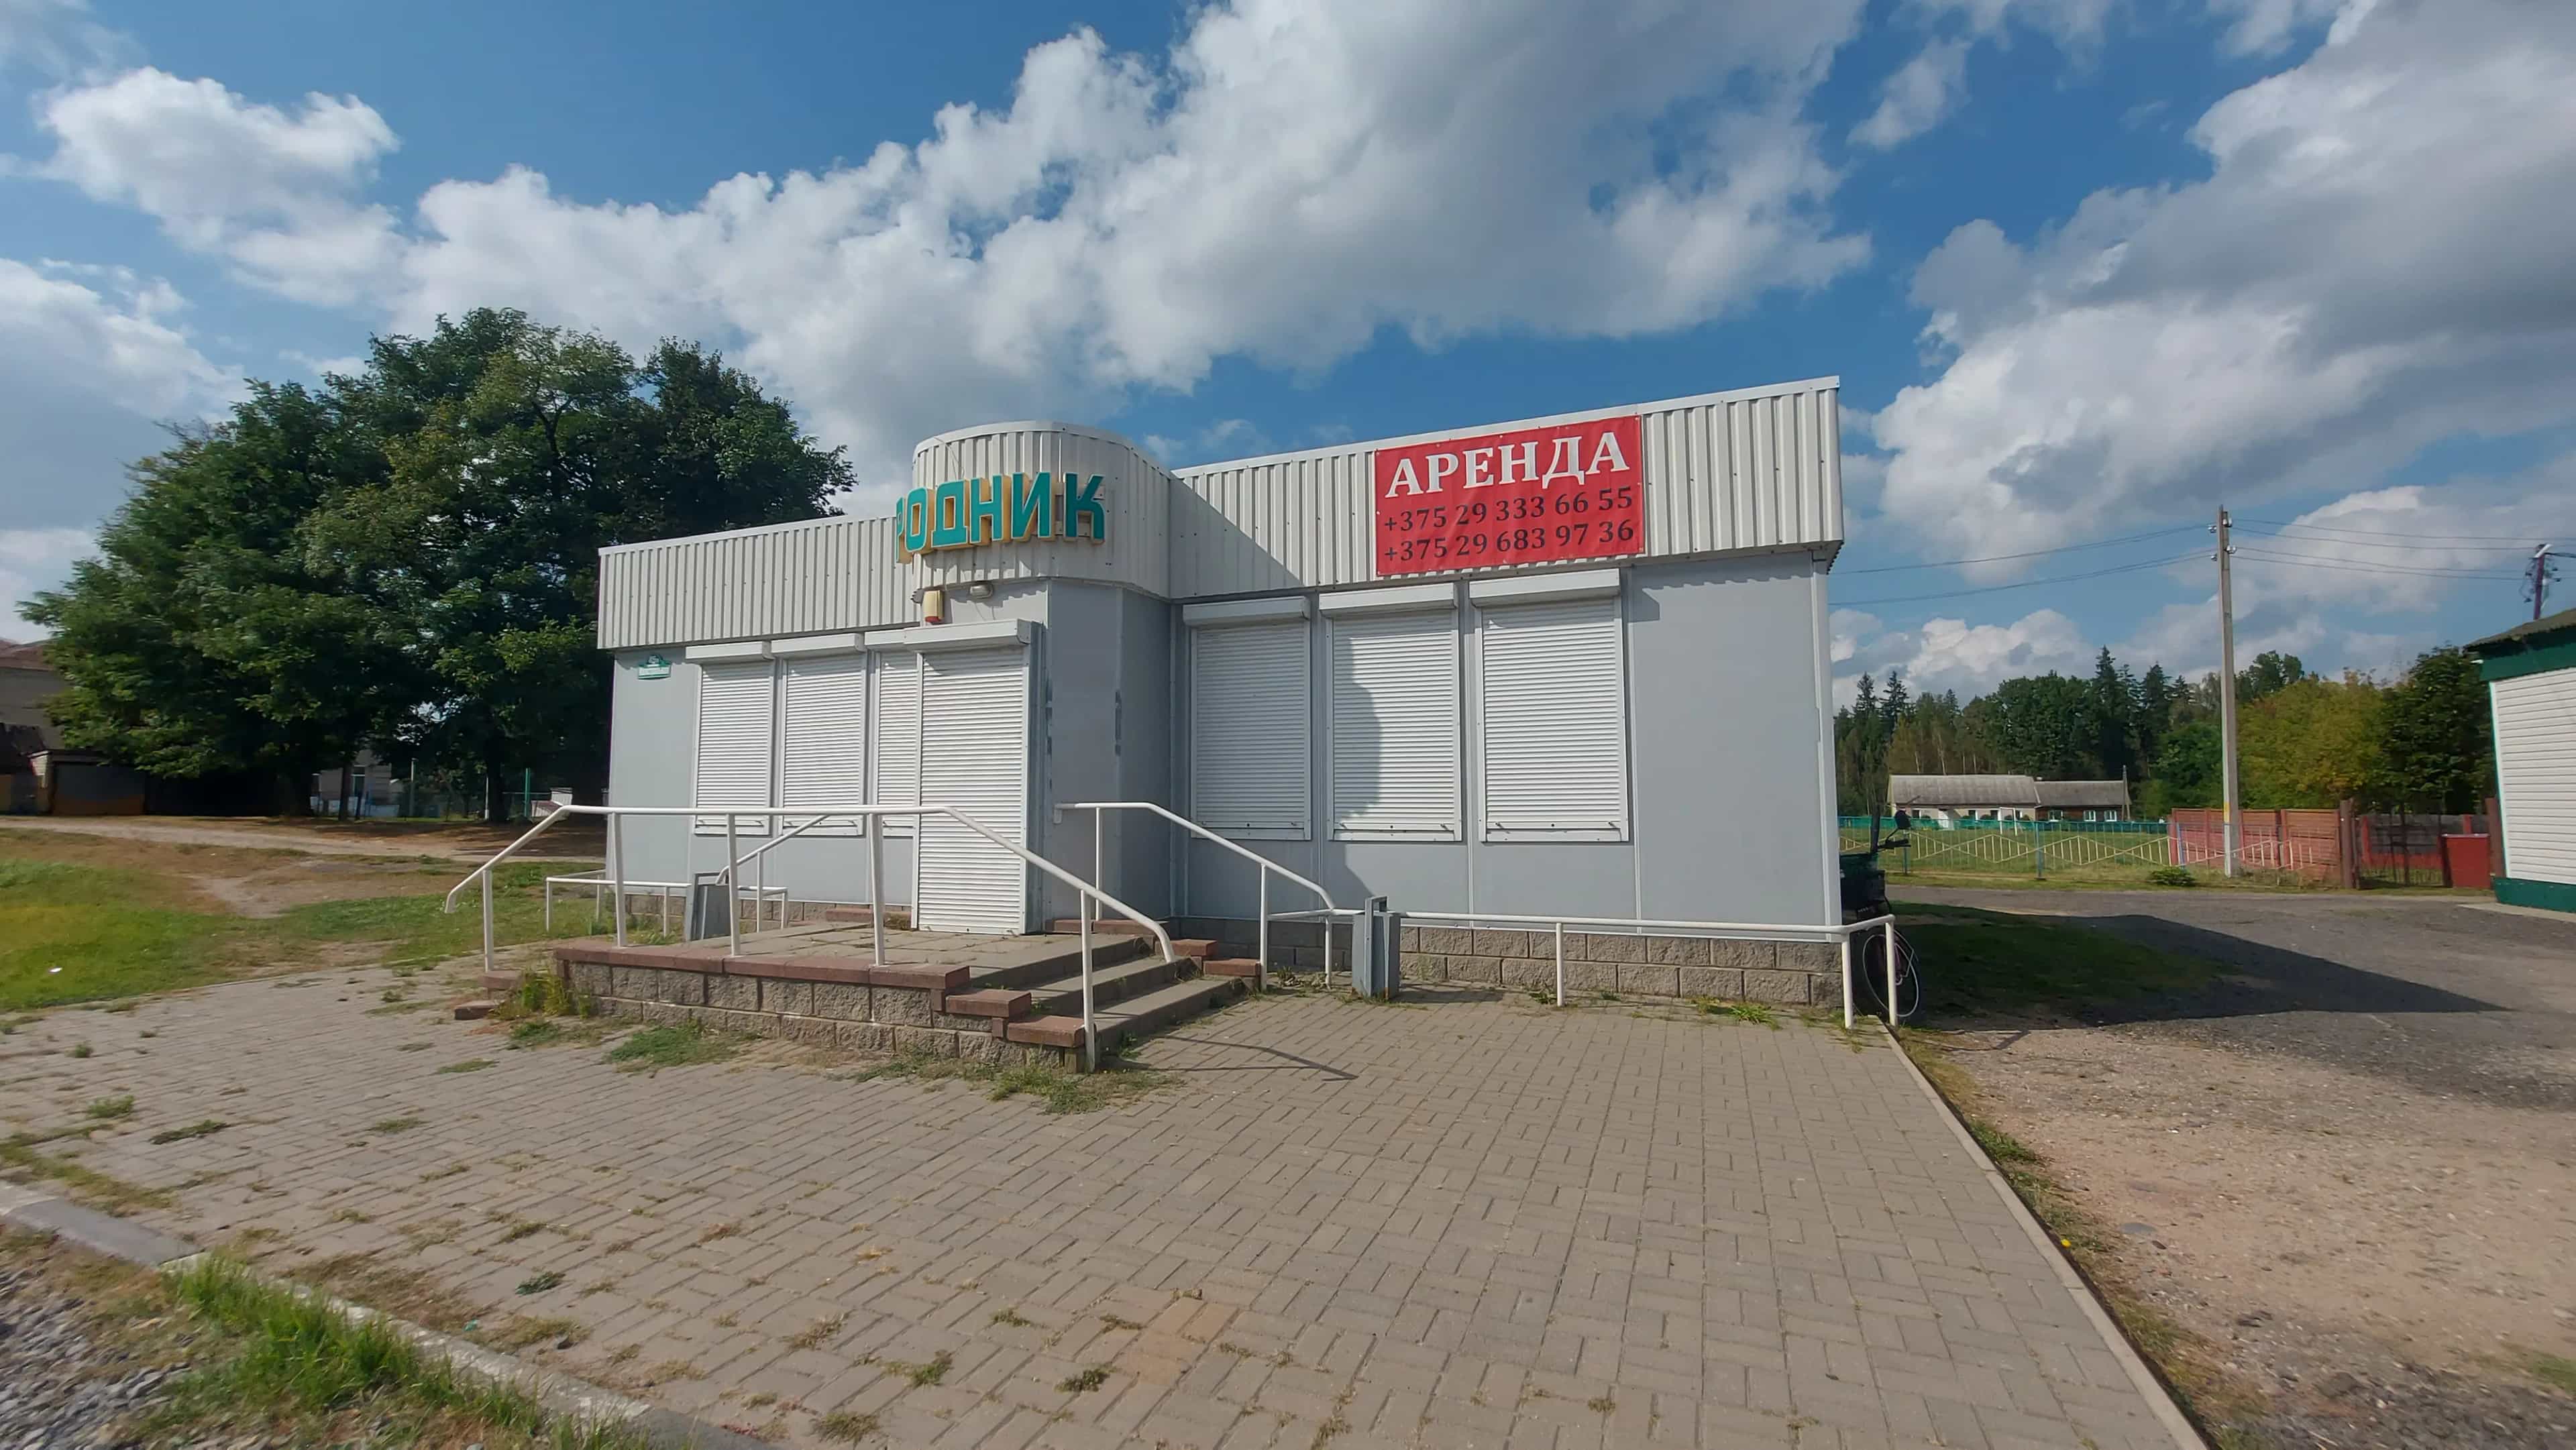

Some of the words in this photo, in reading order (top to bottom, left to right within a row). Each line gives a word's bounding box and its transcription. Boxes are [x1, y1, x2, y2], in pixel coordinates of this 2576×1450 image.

[1384, 431, 1630, 498] АРЕНДА
[896, 471, 1106, 563] РОДНИК
[1385, 508, 1447, 532] +375
[1456, 502, 1487, 526] 29
[1495, 496, 1545, 522] 333
[1555, 492, 1589, 514] 66
[1599, 486, 1632, 510] 55
[1385, 539, 1448, 562] +375
[1456, 533, 1487, 556] 29
[1497, 528, 1546, 552] 683
[1556, 523, 1589, 547] 97
[1599, 519, 1633, 543] 36
